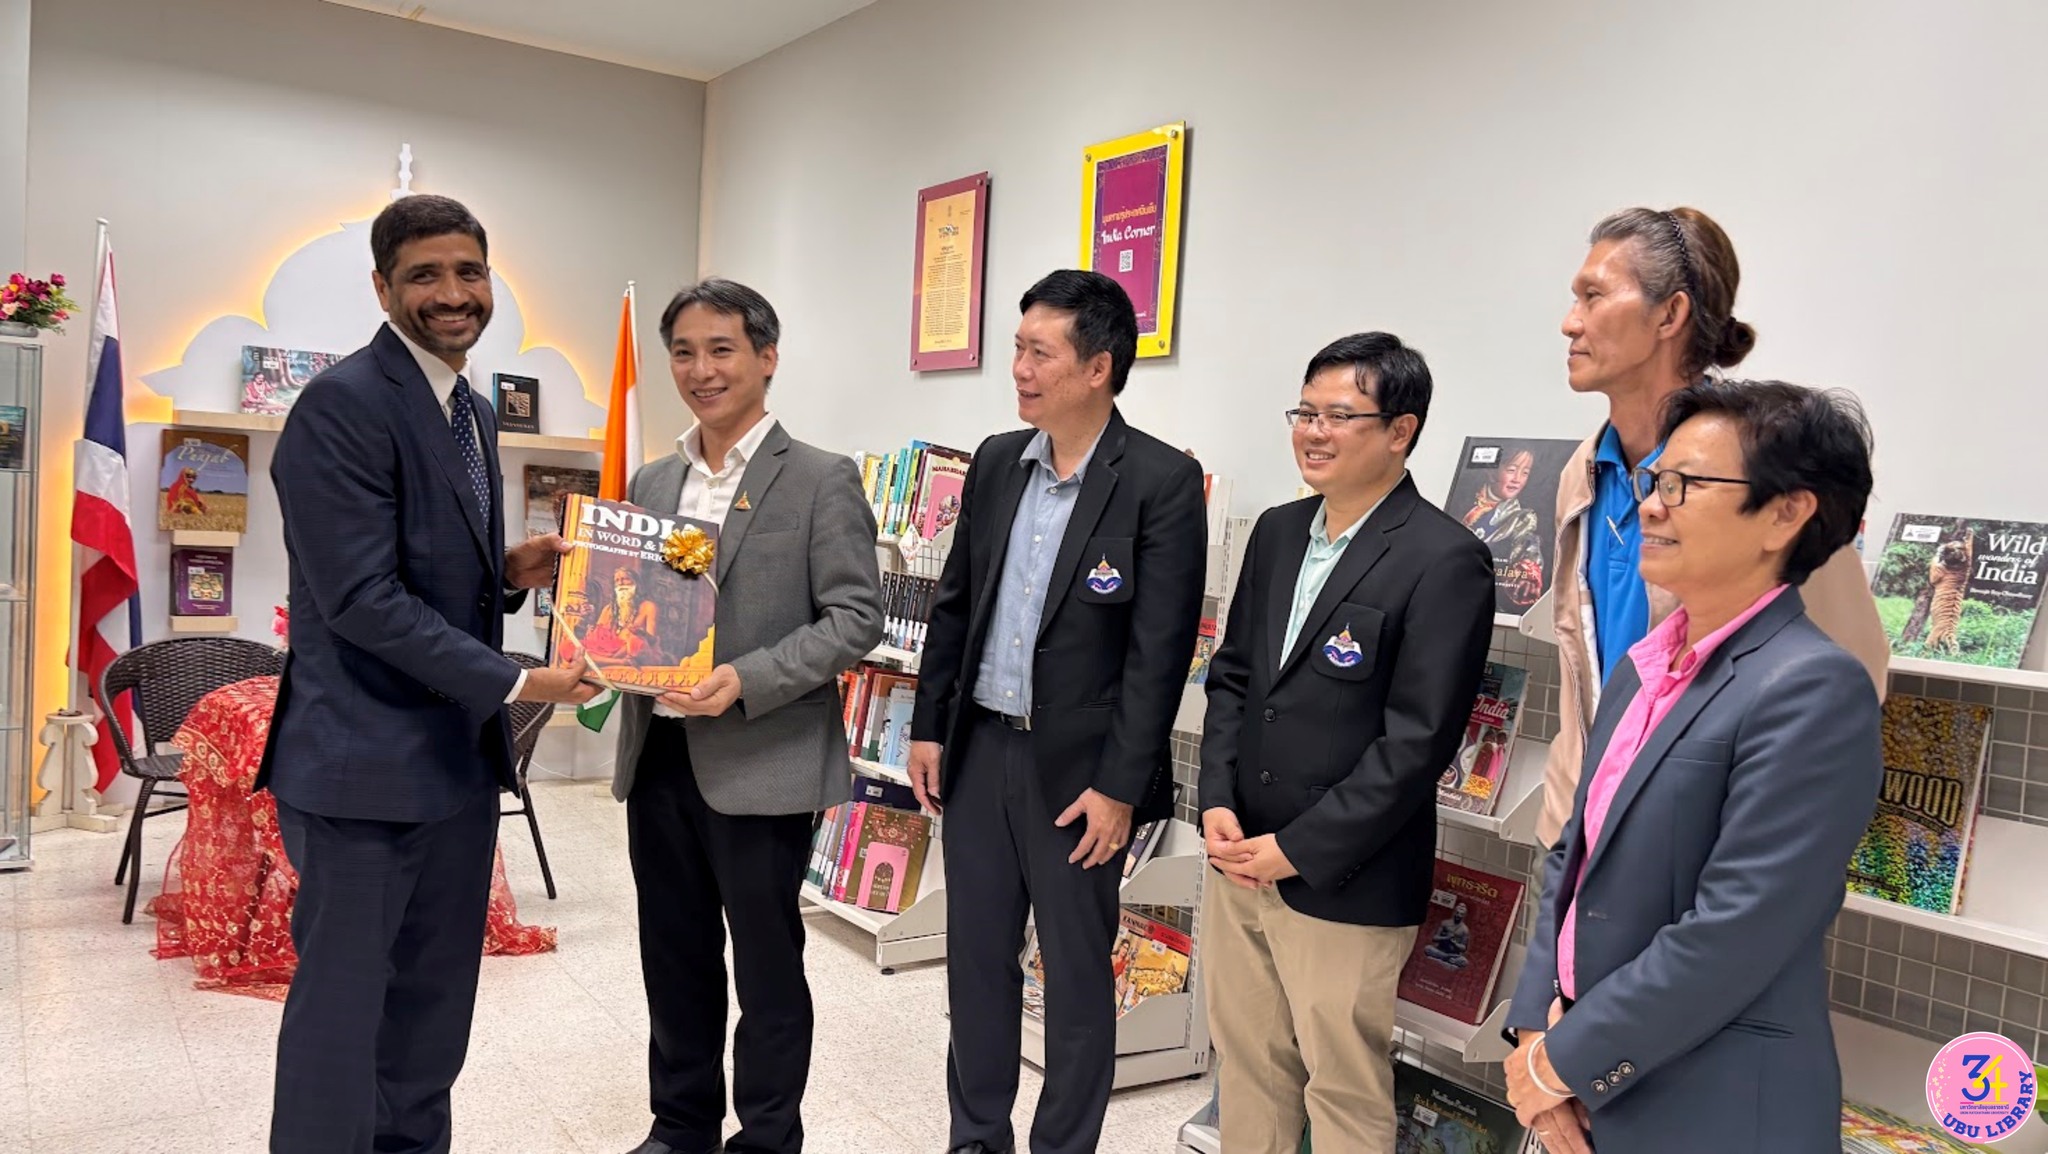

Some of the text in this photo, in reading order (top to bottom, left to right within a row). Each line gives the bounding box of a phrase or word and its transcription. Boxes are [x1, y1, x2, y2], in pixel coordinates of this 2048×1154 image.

[1101, 225, 1156, 244] India Corner
[582, 504, 696, 540] INDI
[578, 527, 594, 539] IN
[597, 530, 641, 548] WORD
[644, 540, 656, 551] &
[1989, 534, 2047, 555] Wild
[1975, 562, 2038, 584] India
[2023, 555, 2039, 568] of
[1472, 693, 1510, 720] India
[1884, 772, 1962, 827] WOOD
